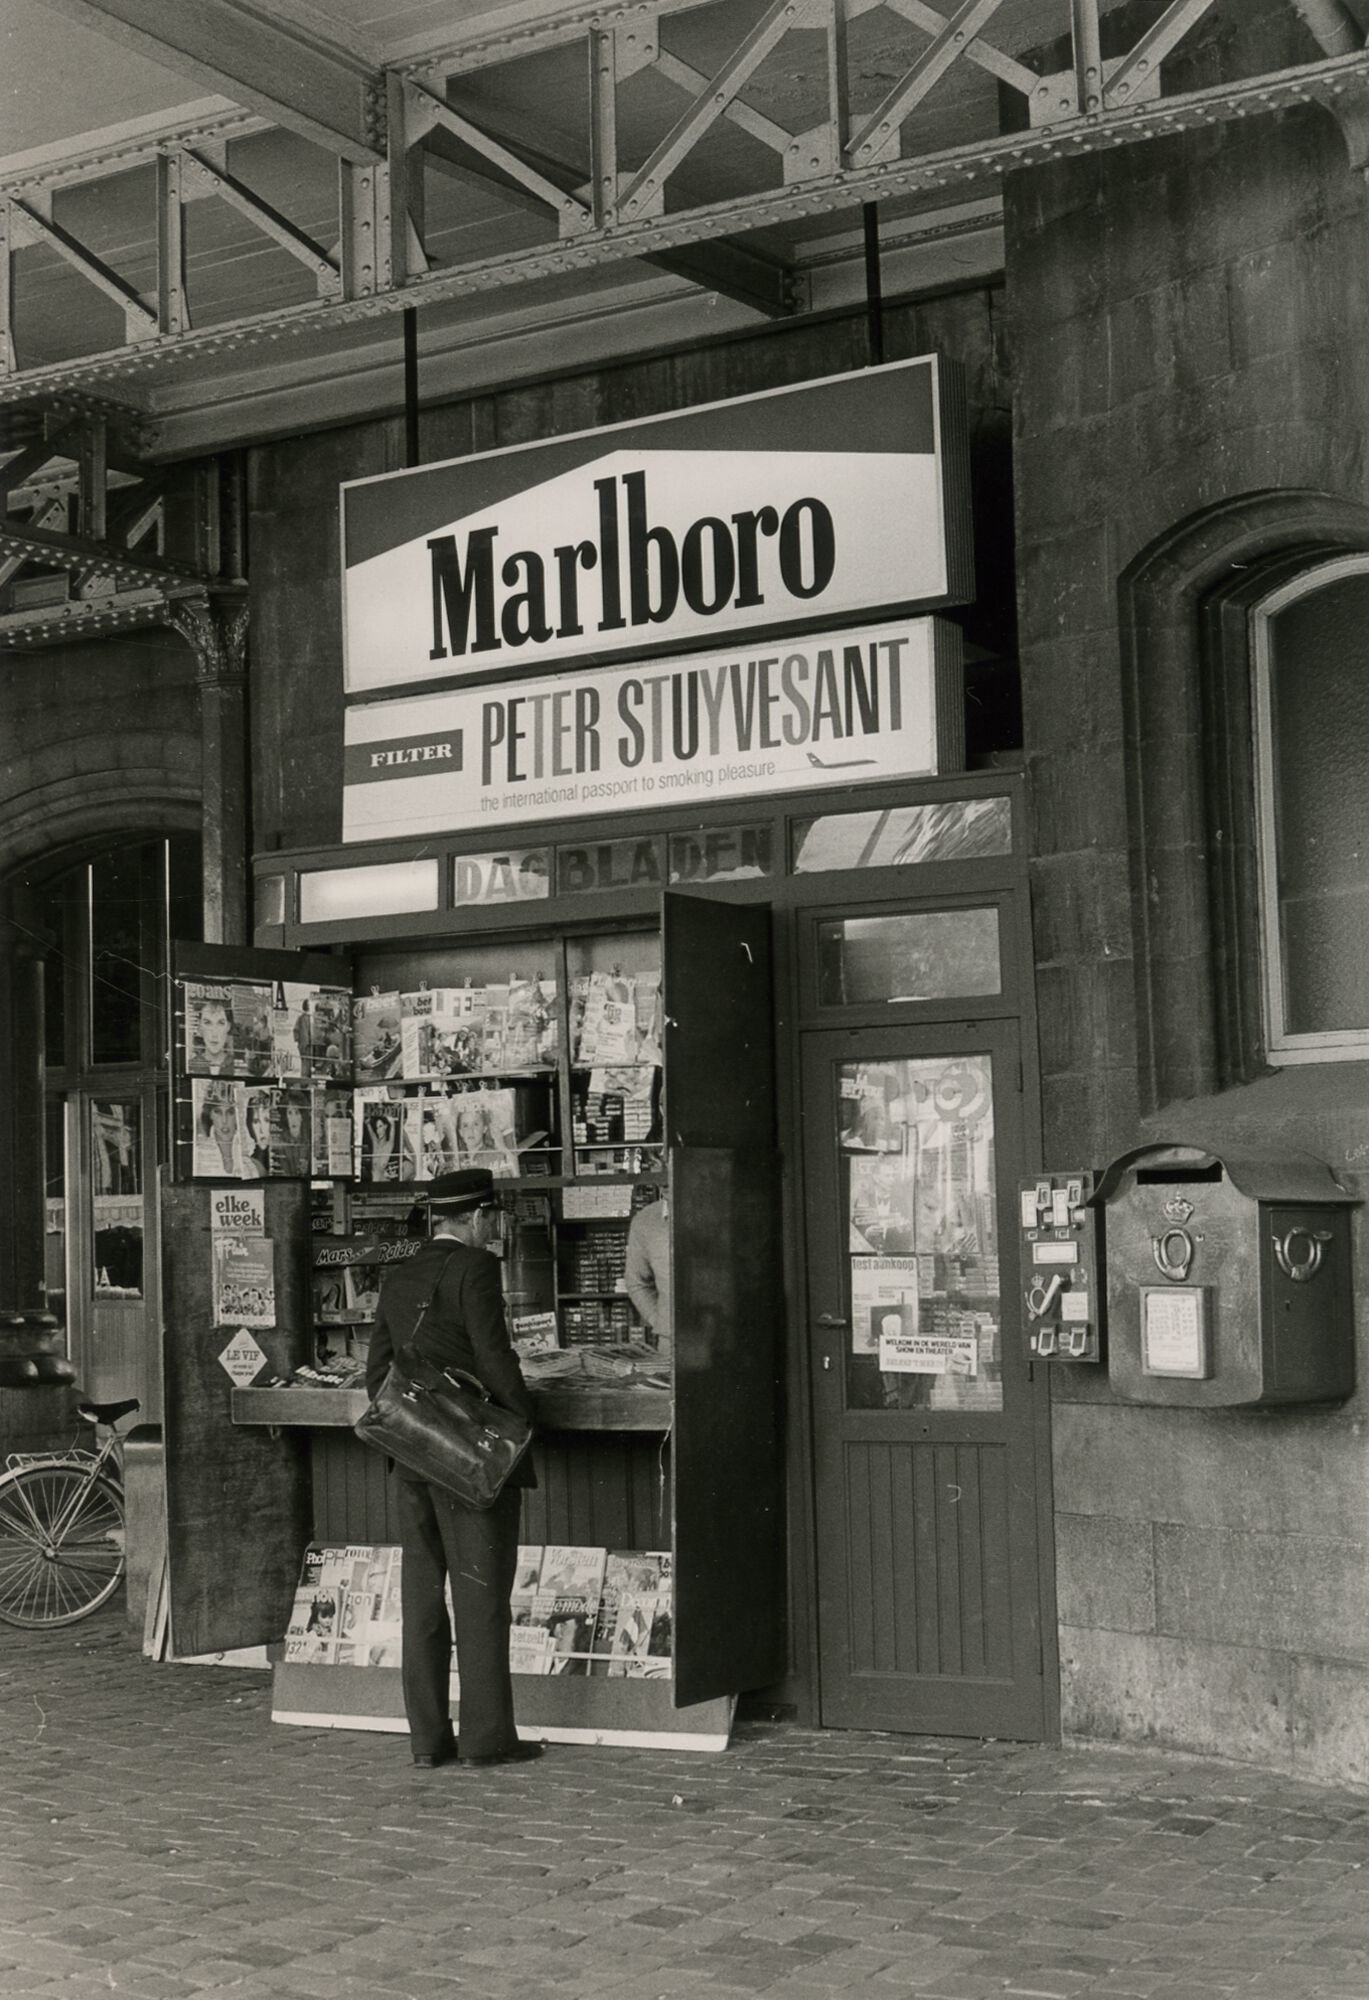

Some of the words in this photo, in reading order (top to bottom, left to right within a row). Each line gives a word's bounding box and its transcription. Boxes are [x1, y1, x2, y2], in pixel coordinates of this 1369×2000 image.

[427, 470, 836, 661] Marlboro
[481, 686, 601, 786] PETER
[618, 637, 909, 769] STUYVESANT
[370, 743, 453, 767] FILTER
[481, 795, 499, 812] the
[503, 784, 578, 808] international
[582, 777, 638, 802] passport
[642, 775, 655, 791] to
[659, 768, 714, 790] smoking
[718, 761, 776, 785] pleasure
[215, 1195, 250, 1213] elke
[219, 1208, 262, 1227] week
[316, 1248, 354, 1265] Mars
[378, 1239, 421, 1263] Raider
[852, 1258, 873, 1270] test
[873, 1259, 914, 1272] aankoop
[925, 1347, 953, 1355] THEATER
[931, 1340, 956, 1348] WERELD
[958, 1341, 971, 1349] VAN
[226, 1350, 240, 1361] LE
[242, 1350, 260, 1361] VIF
